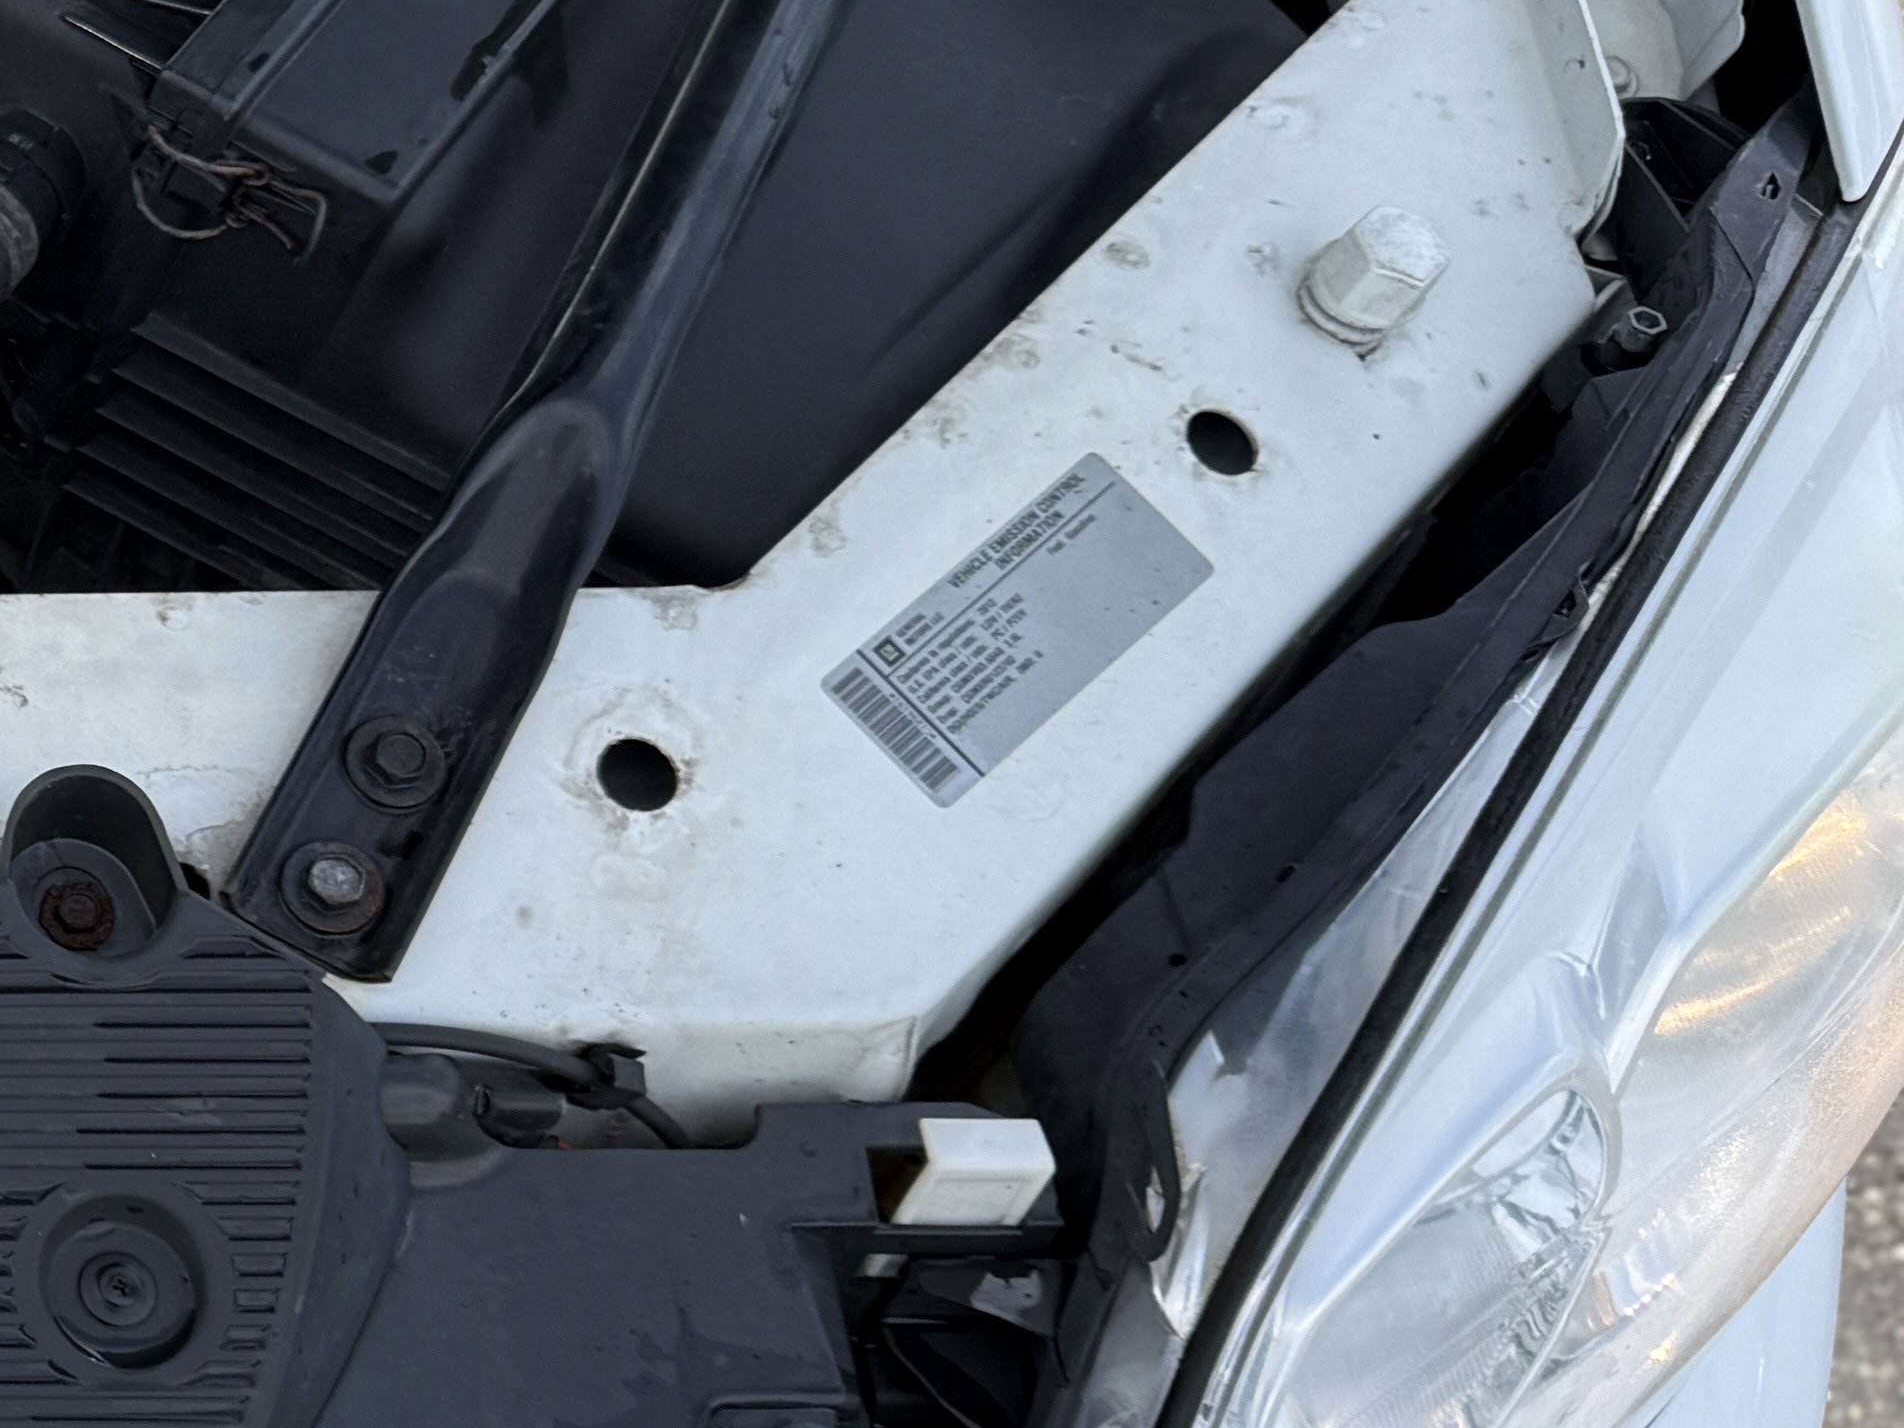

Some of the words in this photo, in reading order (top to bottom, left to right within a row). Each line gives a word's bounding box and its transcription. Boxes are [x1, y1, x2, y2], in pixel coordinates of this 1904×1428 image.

[946, 547, 993, 591] VEHICLE
[987, 506, 1041, 556] EMISSION
[1037, 469, 1086, 516] CONTROL
[993, 506, 1064, 572] INFORMATION
